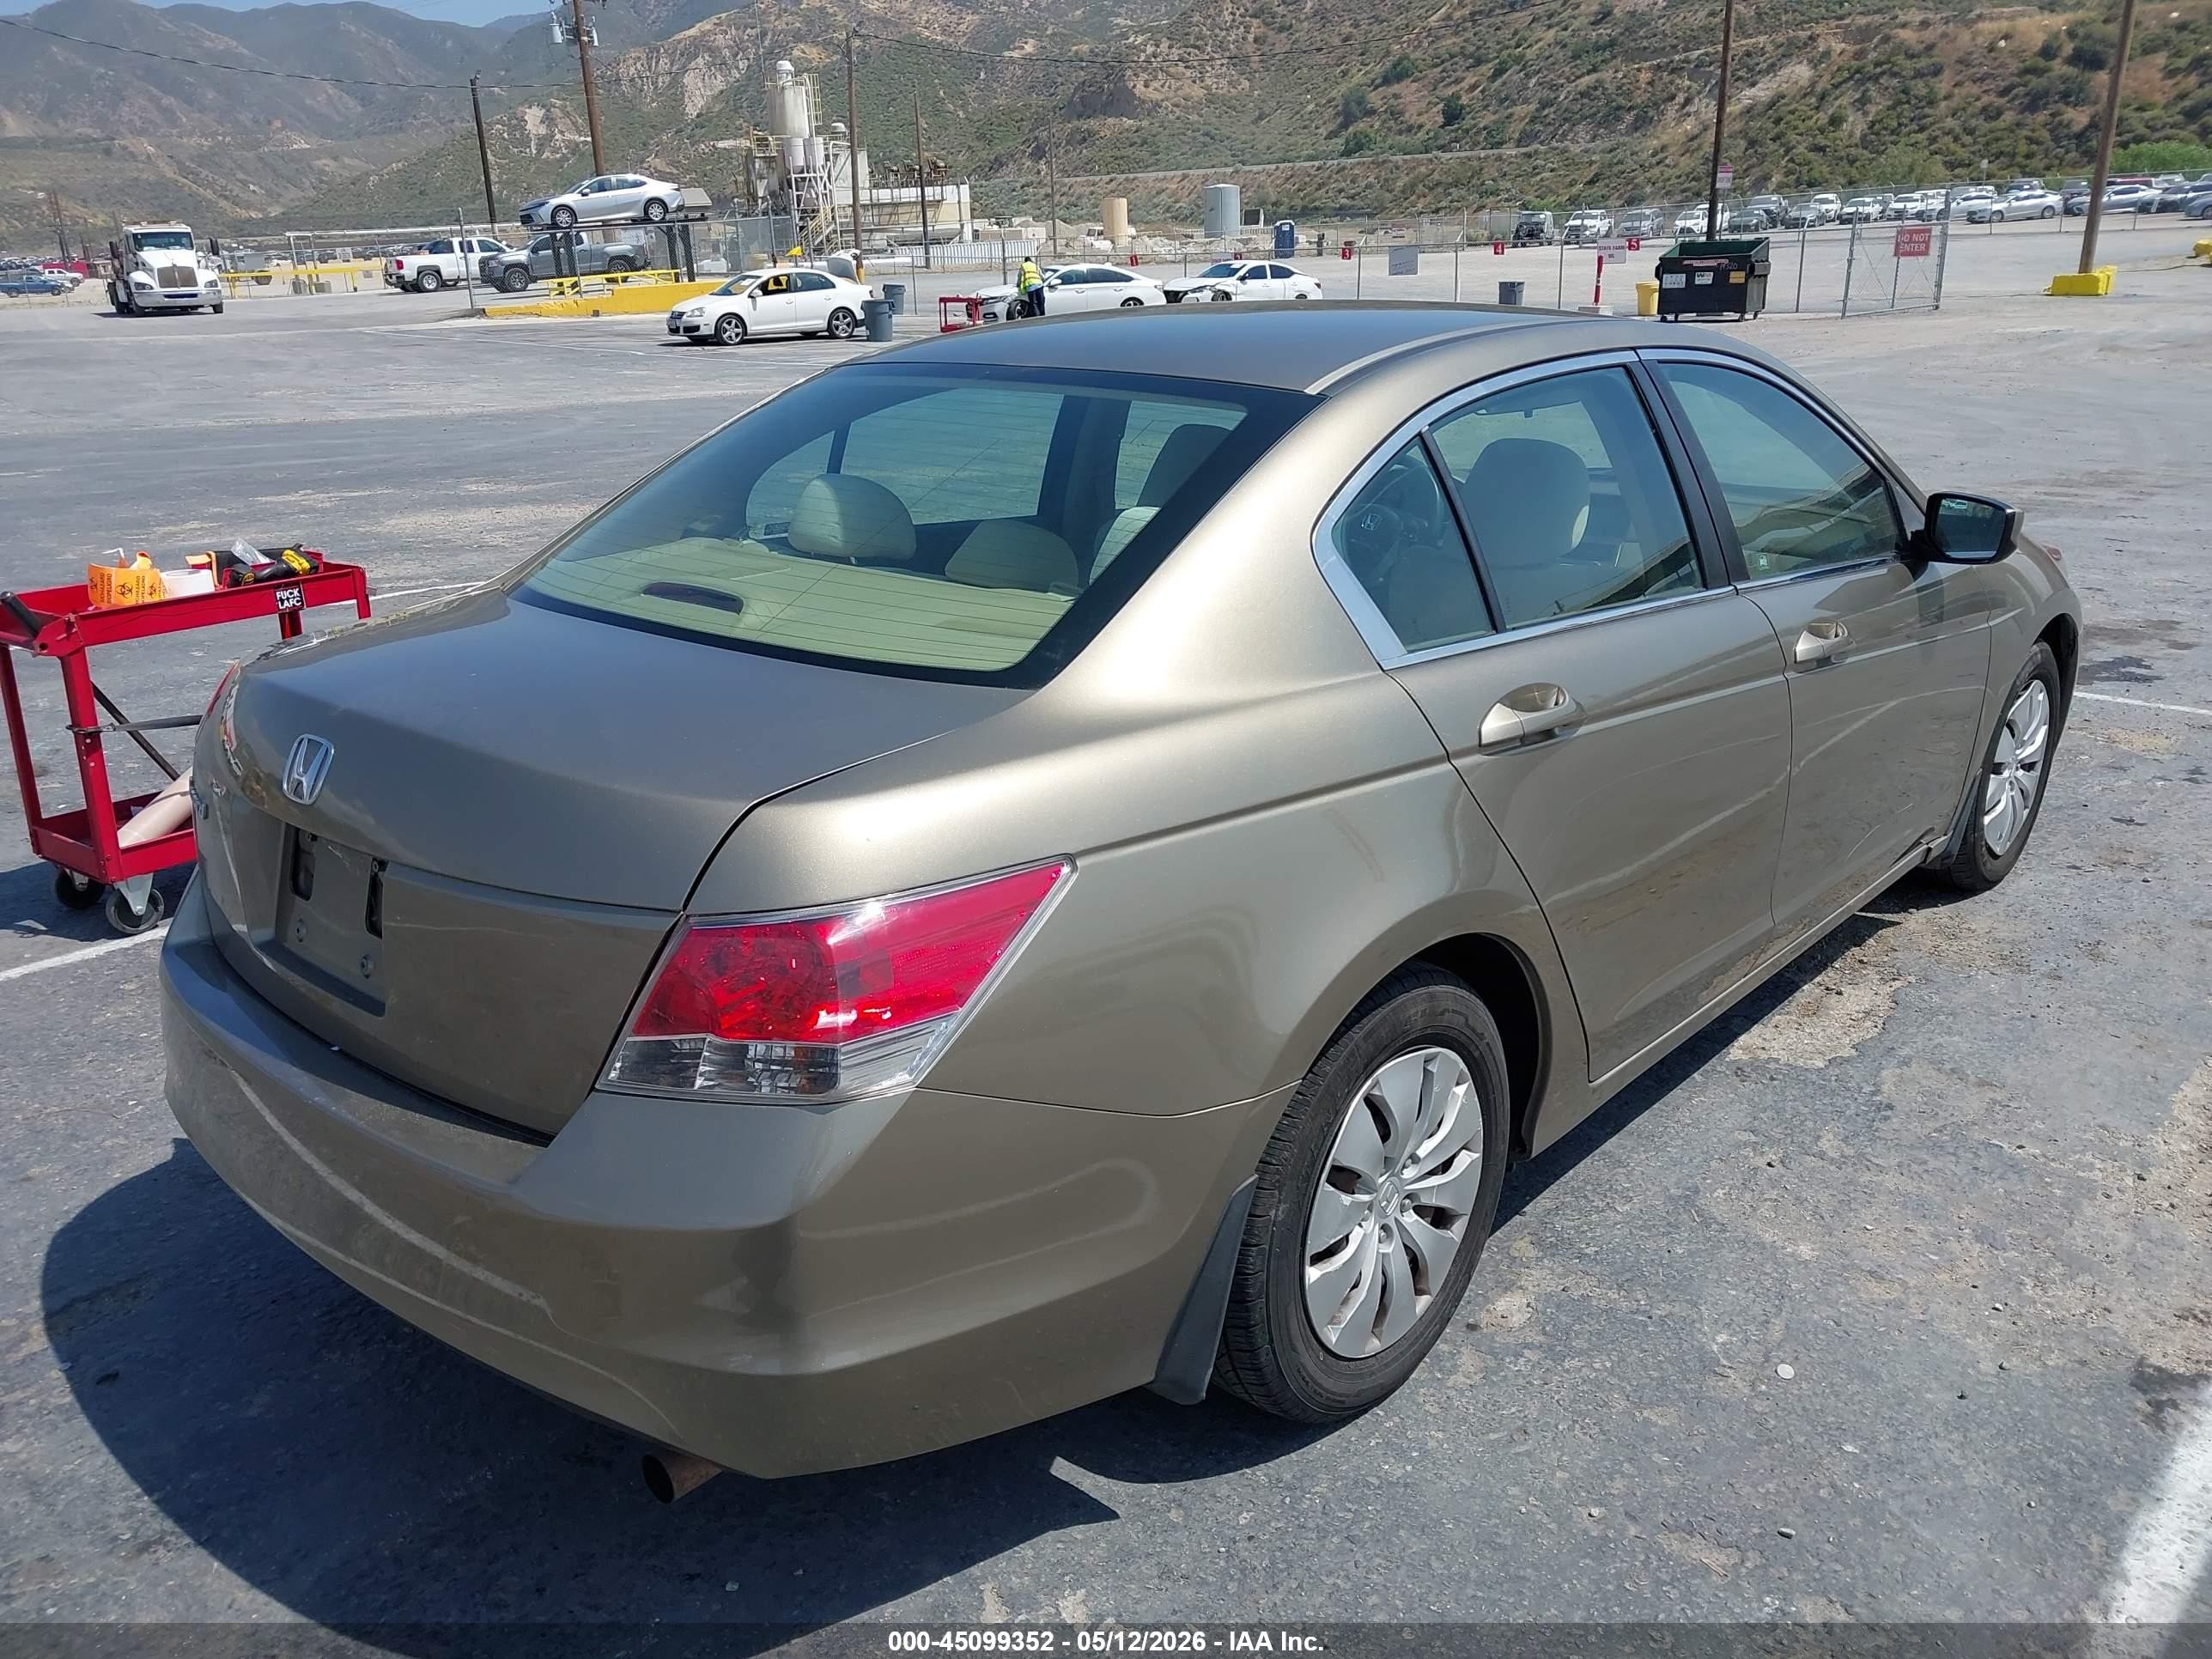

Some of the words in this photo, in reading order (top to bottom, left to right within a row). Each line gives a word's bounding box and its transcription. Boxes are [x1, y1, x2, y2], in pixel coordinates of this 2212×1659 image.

[1912, 233, 1930, 242] NOT
[1496, 242, 1502, 255] 4
[1631, 238, 1638, 250] 5
[1343, 248, 1350, 259] 3
[276, 587, 301, 600] FUCK
[277, 598, 302, 610] LAFC
